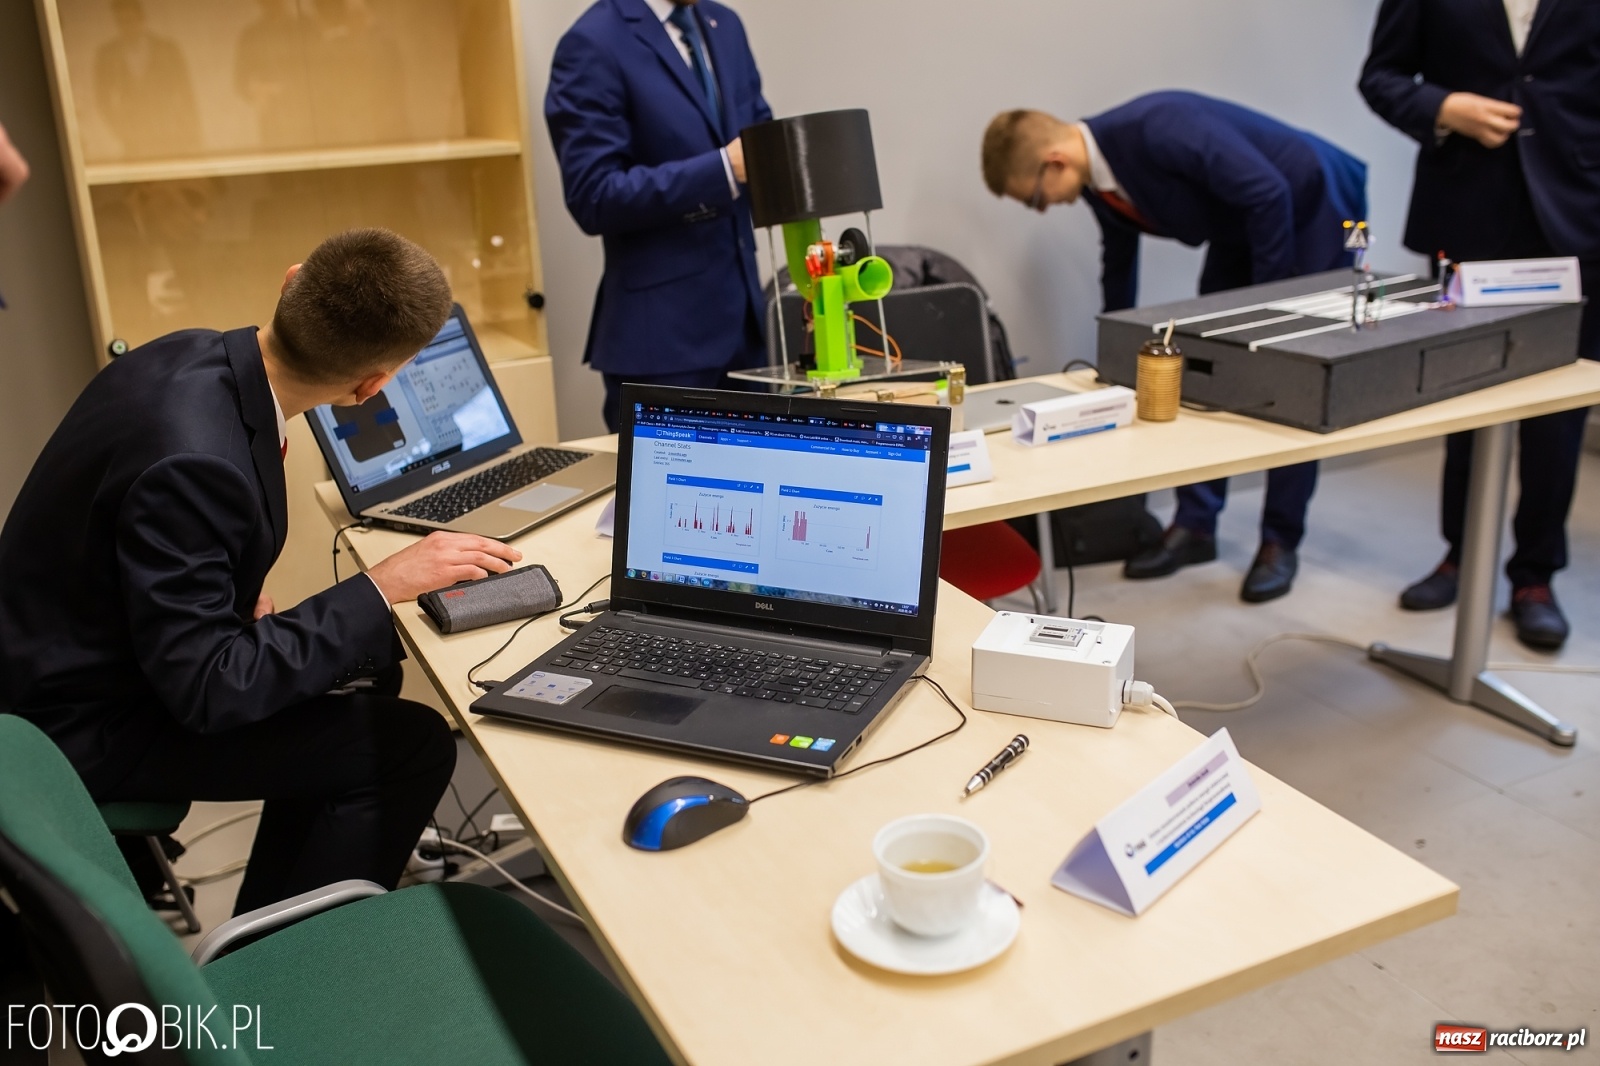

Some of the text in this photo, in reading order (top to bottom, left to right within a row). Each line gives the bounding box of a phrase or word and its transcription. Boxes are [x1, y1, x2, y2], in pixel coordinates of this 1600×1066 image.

[662, 430, 691, 438] ThingSpeak
[654, 441, 676, 449] Channel
[432, 461, 451, 475] ASUS
[755, 601, 774, 611] DELL
